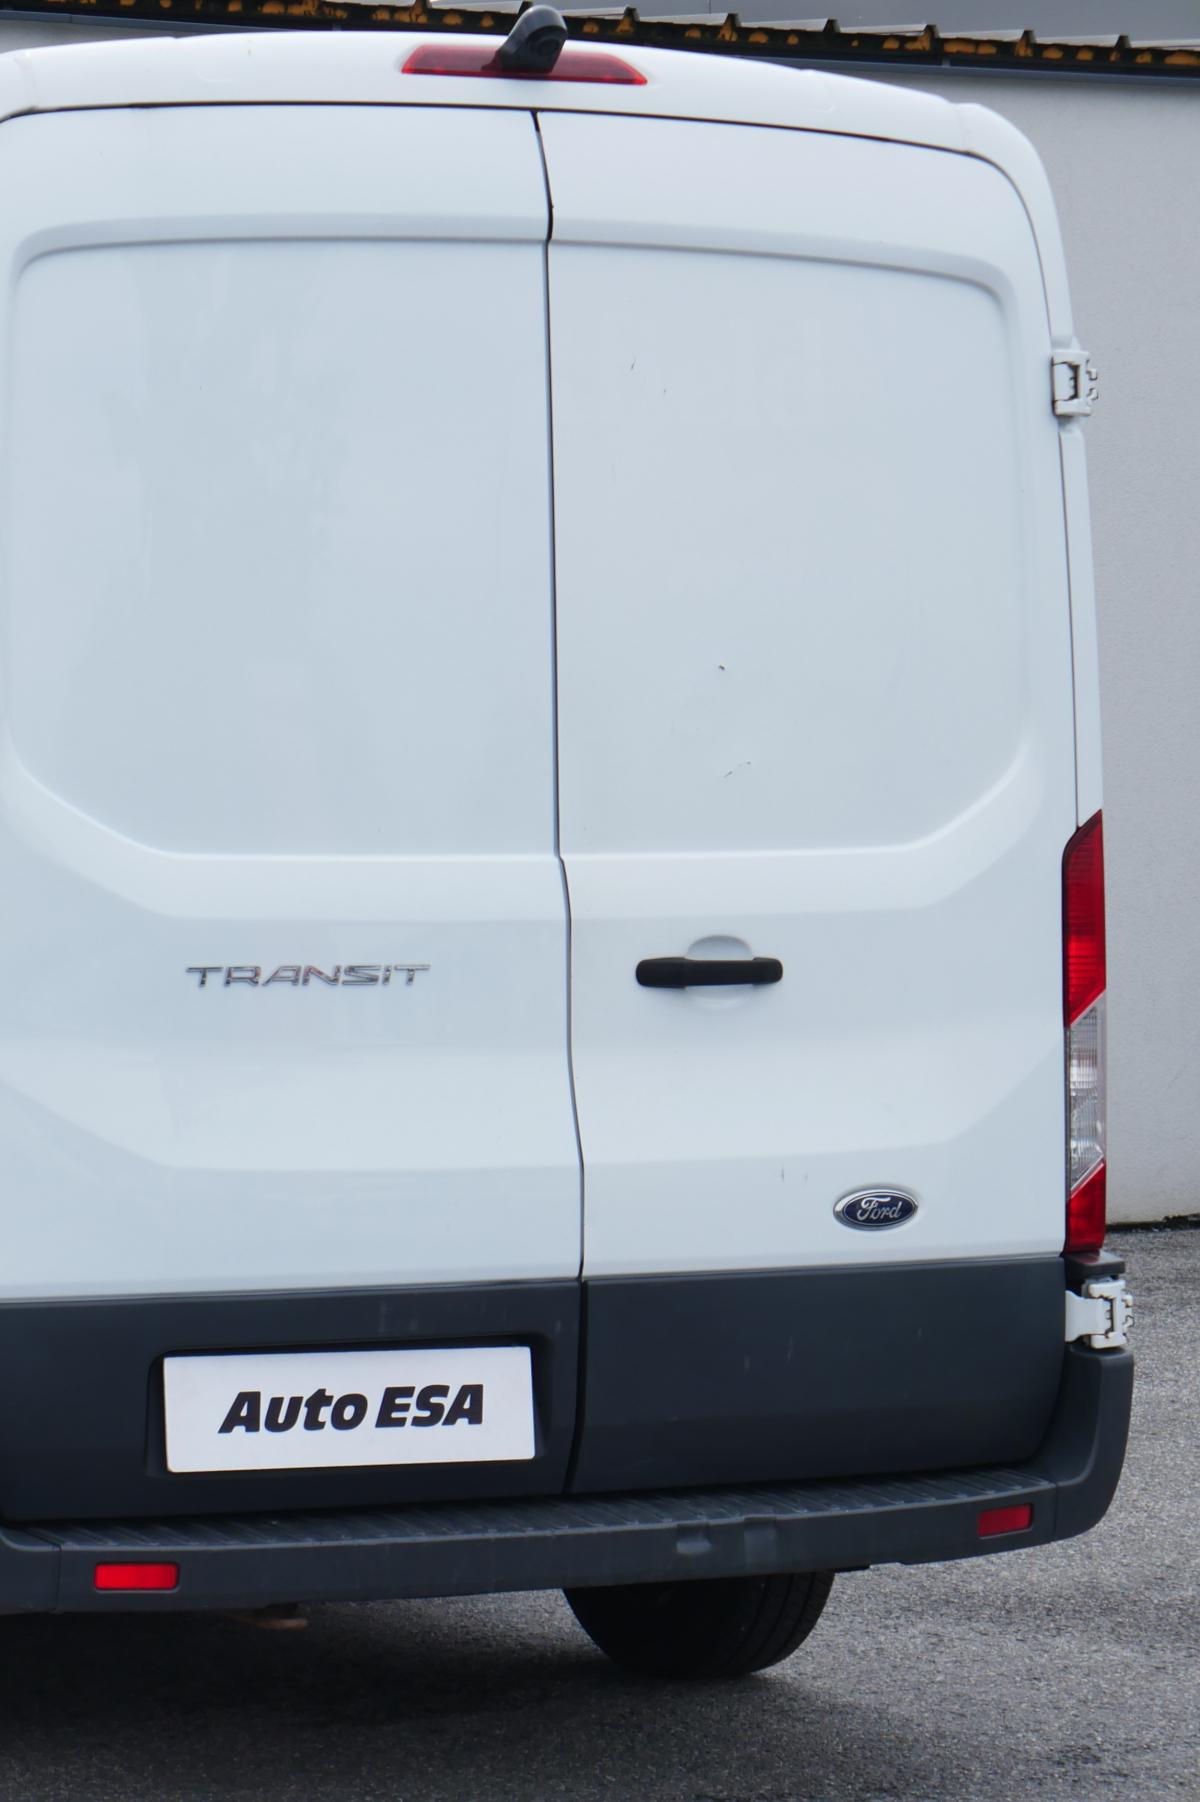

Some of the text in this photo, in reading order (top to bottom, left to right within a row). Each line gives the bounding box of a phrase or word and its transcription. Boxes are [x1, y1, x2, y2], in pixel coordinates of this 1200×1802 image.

[186, 964, 431, 987] TRANSIT
[856, 1197, 902, 1221] Ford
[217, 1384, 484, 1434] Auto ESA
